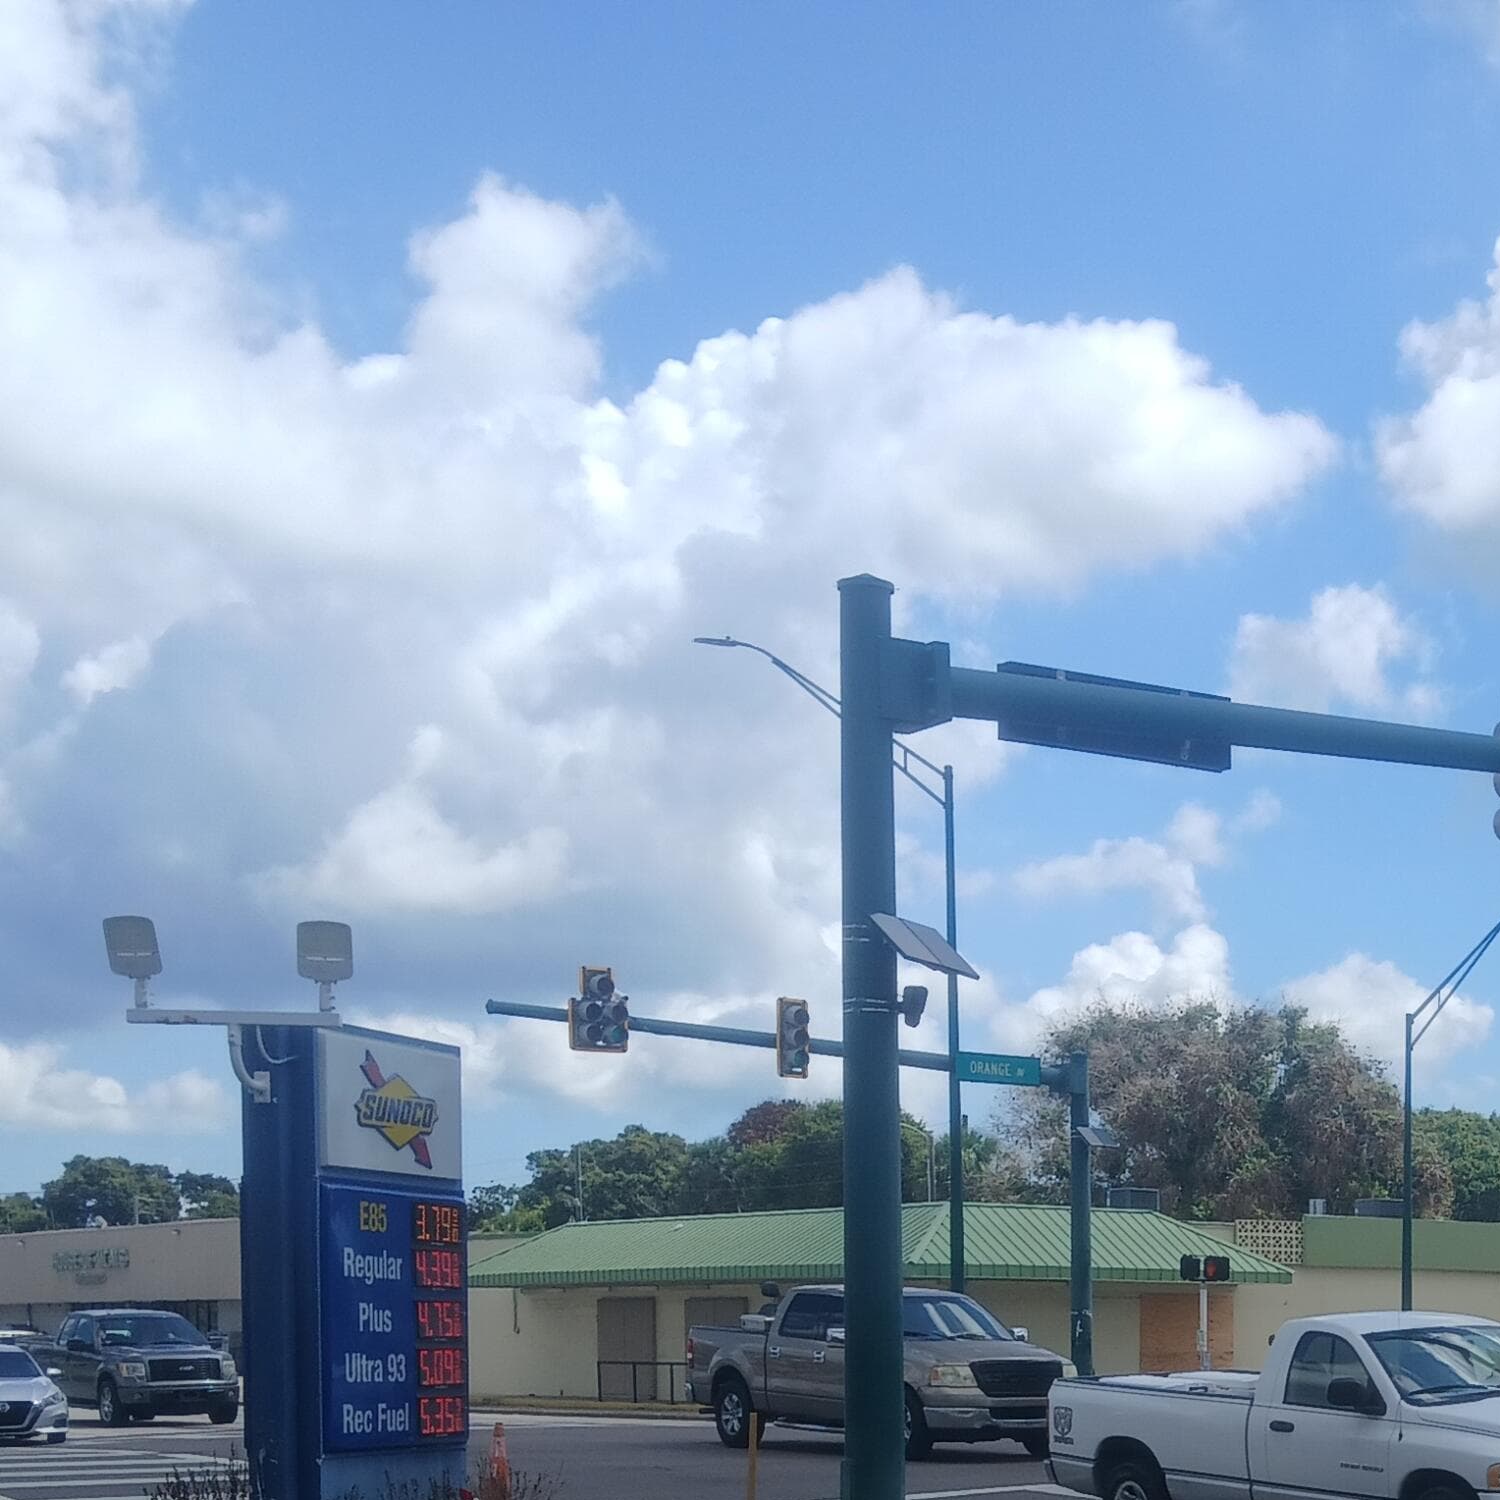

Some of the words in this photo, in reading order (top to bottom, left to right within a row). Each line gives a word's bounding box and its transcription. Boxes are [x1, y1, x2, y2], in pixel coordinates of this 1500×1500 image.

[970, 1060, 1011, 1077] ORANGE
[362, 1094, 434, 1128] SUNOCO
[360, 1201, 387, 1232] E85
[343, 1247, 402, 1285] Regular
[415, 1250, 451, 1287] 4.39
[359, 1302, 392, 1333] Plus
[418, 1302, 453, 1337] 4.75
[345, 1352, 383, 1383] Ultra
[388, 1353, 406, 1382] 93
[420, 1350, 454, 1386] 5.09
[343, 1403, 372, 1433] Rec
[378, 1402, 409, 1432] Fuel
[420, 1398, 454, 1434] 5.35
